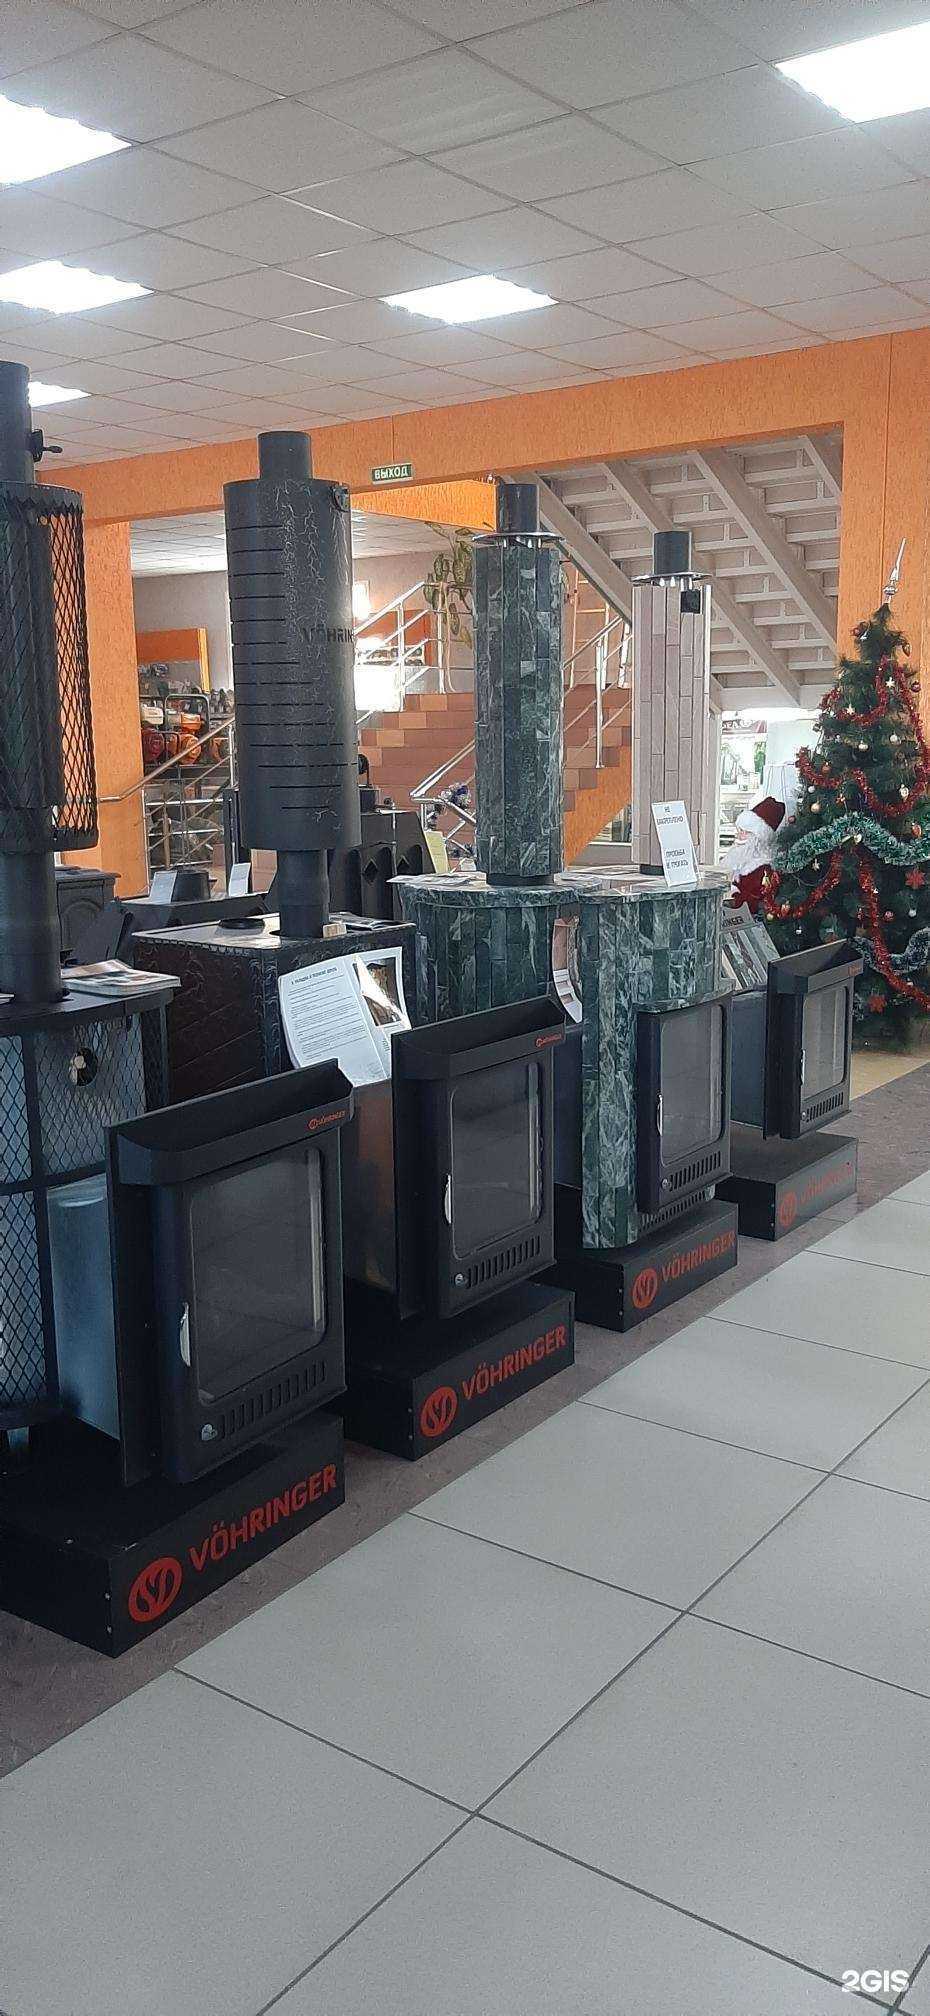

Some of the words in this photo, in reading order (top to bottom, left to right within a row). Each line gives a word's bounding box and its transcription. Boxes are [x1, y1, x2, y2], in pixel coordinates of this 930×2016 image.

[374, 465, 408, 479] ВЫХОД
[660, 1230, 735, 1282] VÖHRINGER
[461, 1324, 567, 1401] VÖHRINGER
[188, 1463, 338, 1573] VÖHRINGER
